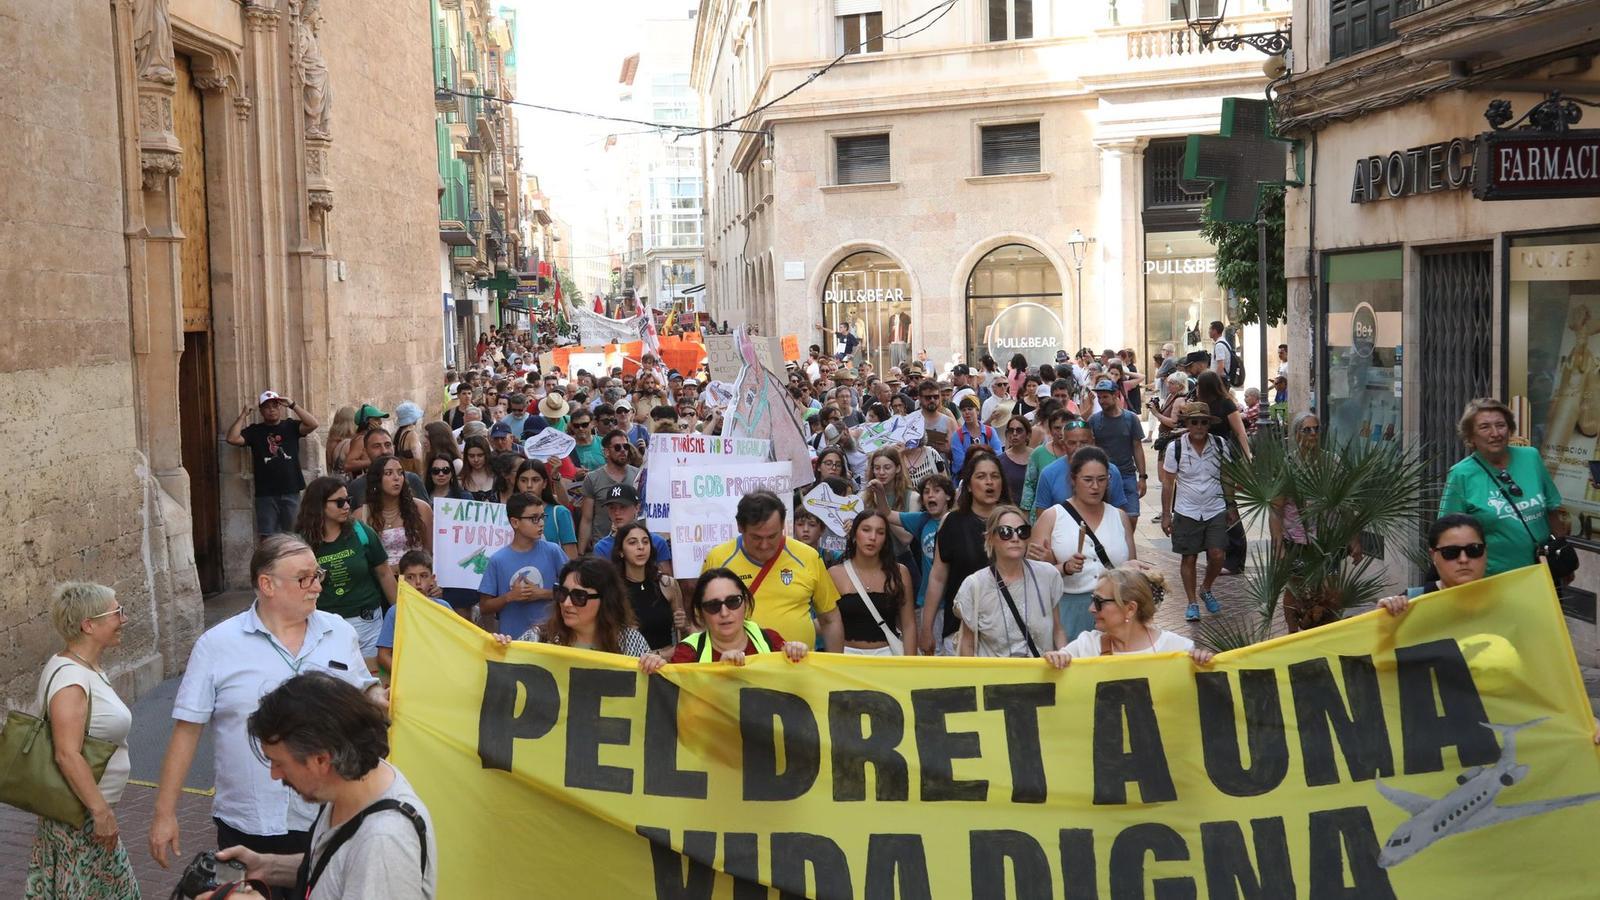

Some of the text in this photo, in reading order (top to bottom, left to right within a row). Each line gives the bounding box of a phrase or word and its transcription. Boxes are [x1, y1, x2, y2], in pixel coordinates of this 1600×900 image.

[1500, 146, 1600, 181] FARMACI
[825, 288, 904, 303] PULL&BEAR
[997, 336, 1056, 349] PULL&BEAR
[671, 435, 705, 453] TURISME
[724, 439, 733, 454] ES
[671, 480, 692, 499] EL
[693, 475, 724, 498] GOB
[478, 637, 1499, 805] PEL DRET A UNA
[635, 805, 1399, 900] VIDA DIGNA
